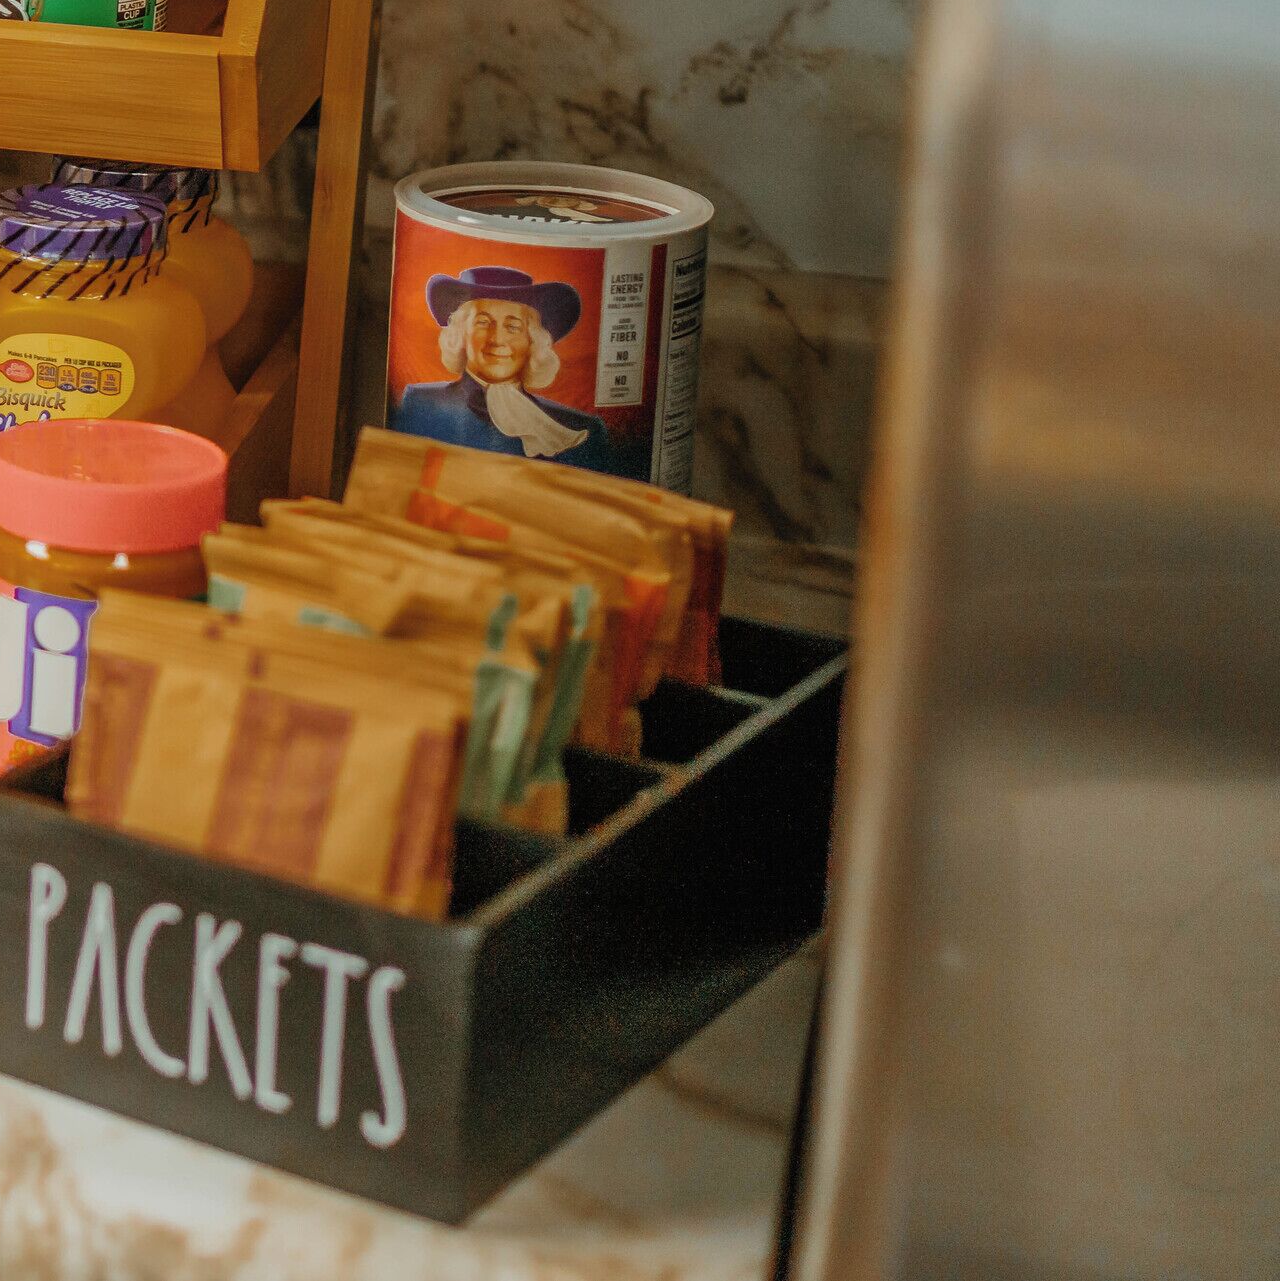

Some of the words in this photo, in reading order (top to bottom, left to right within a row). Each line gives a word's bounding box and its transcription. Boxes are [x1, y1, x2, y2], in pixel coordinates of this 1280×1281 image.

[120, 1, 145, 12] PLASTIC
[123, 10, 140, 20] CUP
[611, 273, 643, 284] LASTING
[610, 283, 643, 295] ENERGY
[610, 331, 637, 343] FIBER
[616, 351, 629, 361] NO
[38, 365, 55, 375] 230
[614, 375, 627, 386] NO
[25, 861, 407, 1149] PACKETS
